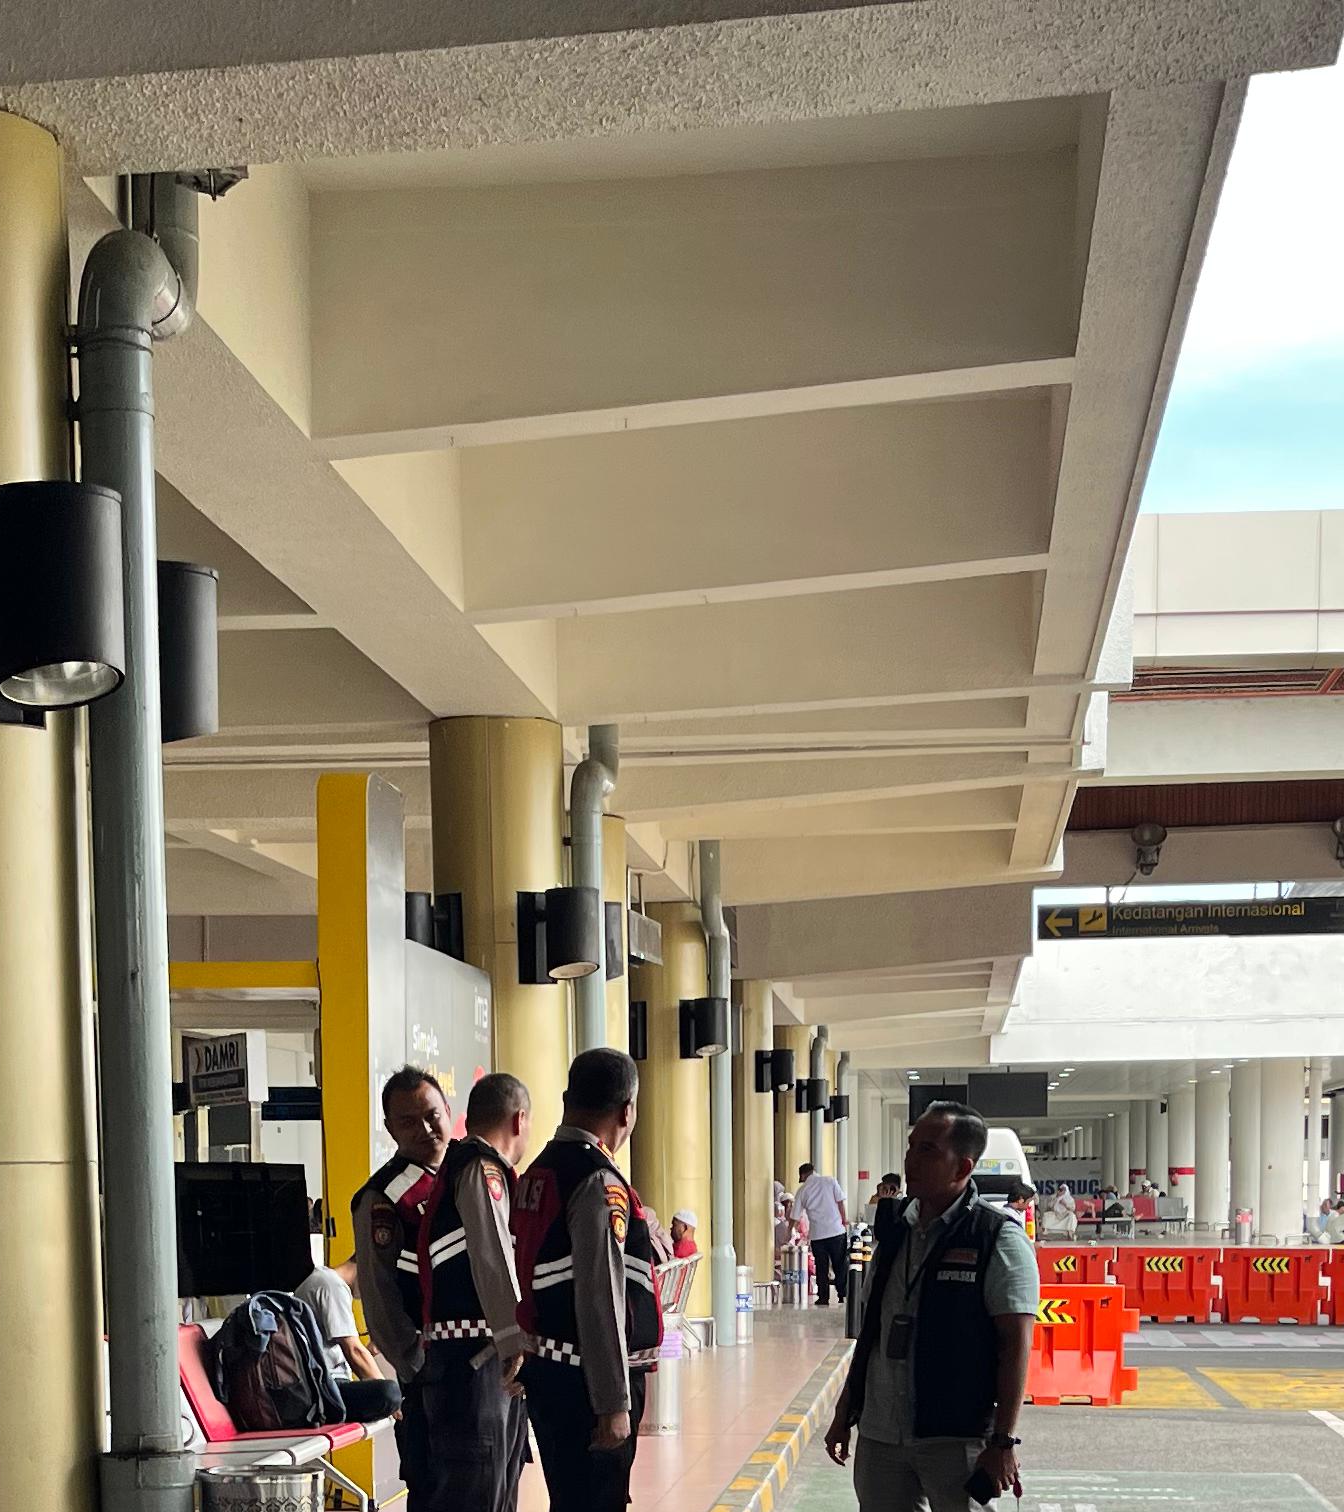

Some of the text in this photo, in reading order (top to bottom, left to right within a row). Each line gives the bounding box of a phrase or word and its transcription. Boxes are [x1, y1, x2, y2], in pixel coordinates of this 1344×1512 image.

[1112, 904, 1204, 922] Kedatangan
[1207, 901, 1305, 918] Internasional
[204, 1040, 240, 1073] DAMRI
